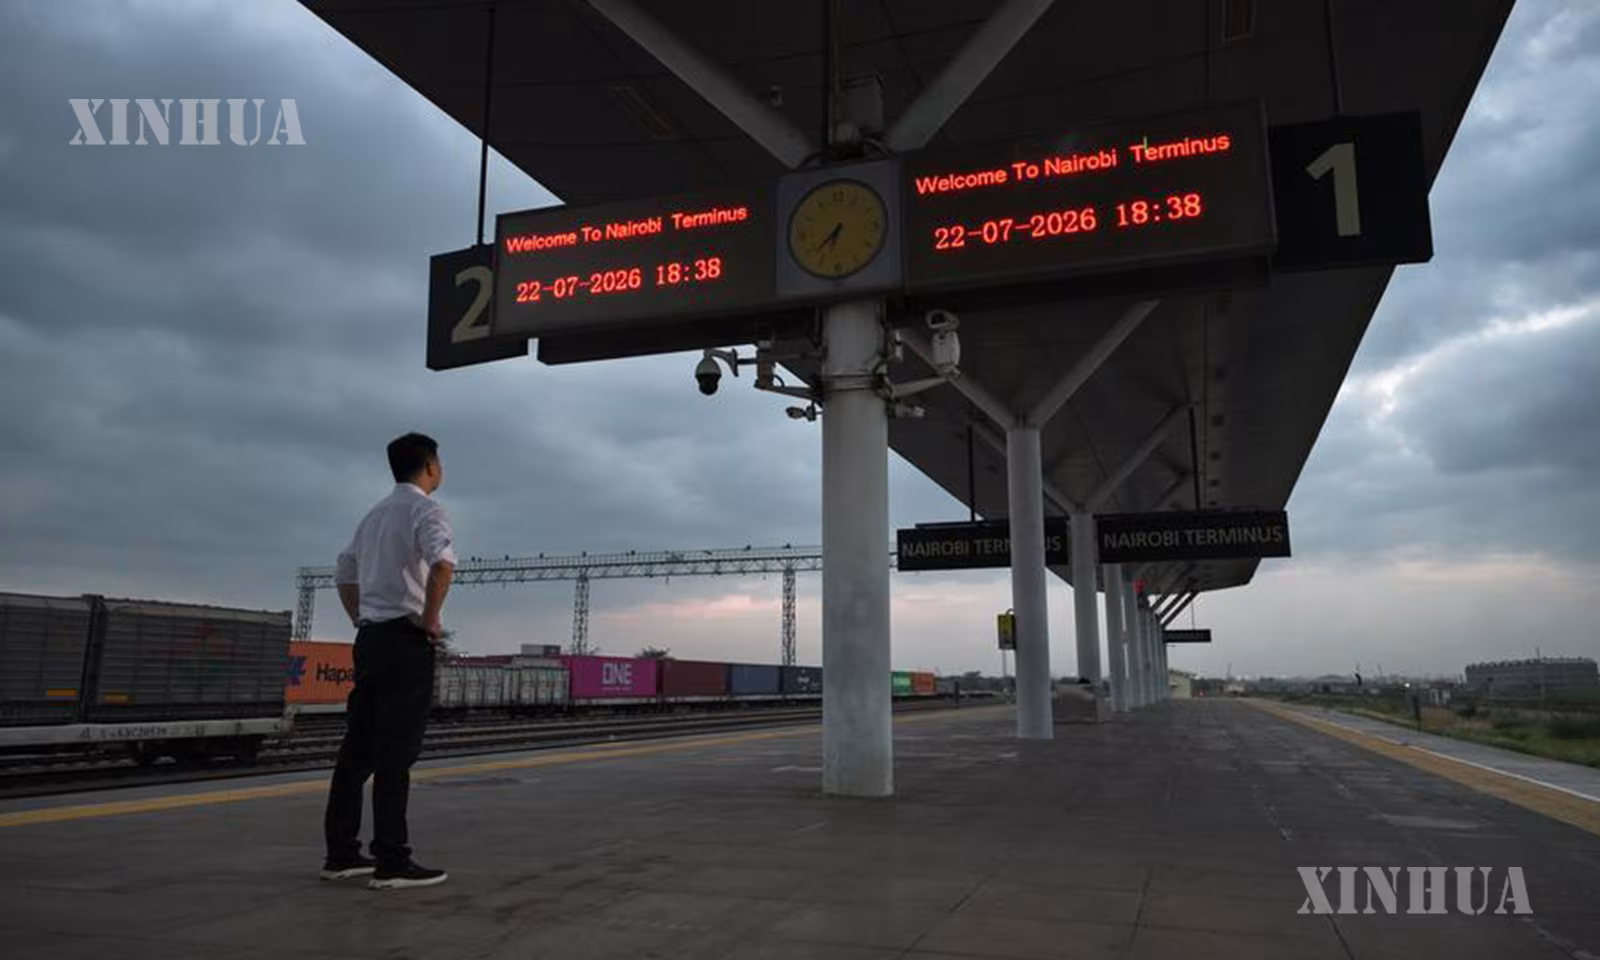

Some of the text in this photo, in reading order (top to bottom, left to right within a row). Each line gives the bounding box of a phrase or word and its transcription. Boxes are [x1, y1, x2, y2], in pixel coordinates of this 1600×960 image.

[916, 135, 1230, 194] Welcome To Nairobi Terminus
[1305, 142, 1362, 236] 1
[506, 207, 747, 253] Welcome To Nairobi Terminus
[935, 194, 1201, 249] 22-07-2026 18:38
[517, 258, 720, 302] 22-07-2026 18:38
[451, 264, 493, 344] 2
[901, 535, 1062, 557] NAIROBI TERS
[1104, 525, 1282, 549] NAIROBI TERMINUS
[602, 662, 632, 684] ONE
